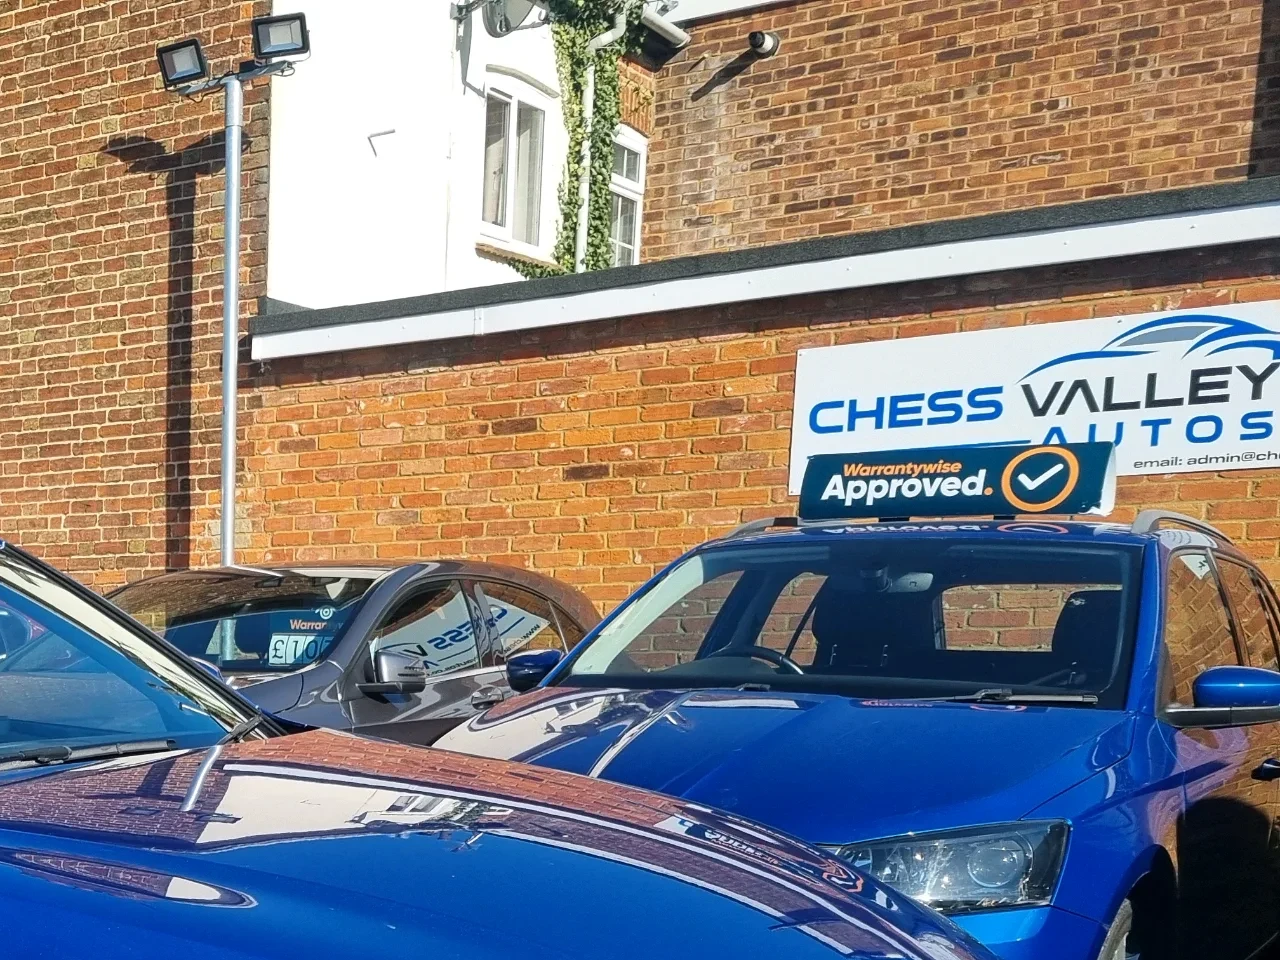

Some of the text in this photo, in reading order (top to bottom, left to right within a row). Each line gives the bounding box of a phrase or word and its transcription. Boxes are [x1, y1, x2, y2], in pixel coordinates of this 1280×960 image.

[809, 362, 1280, 434] CHESS VALLEY
[1041, 411, 1273, 447] AUTOS
[843, 459, 962, 477] Warrantywise
[1133, 450, 1280, 469] email: admin@ch
[820, 469, 994, 506] Approved.
